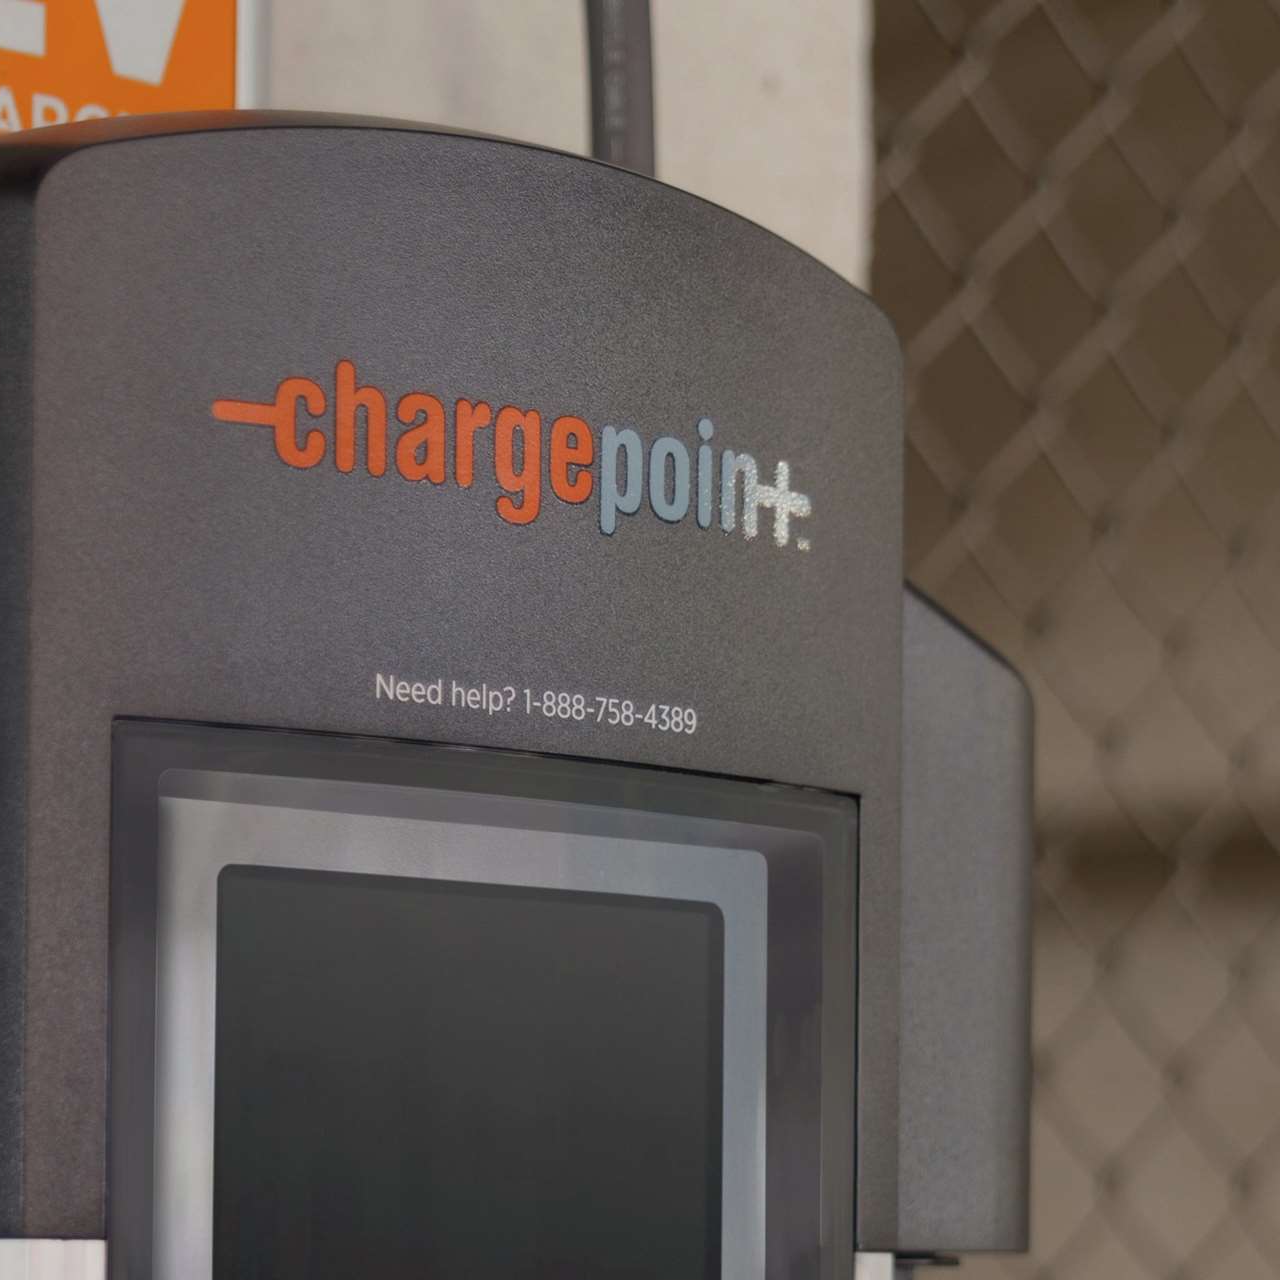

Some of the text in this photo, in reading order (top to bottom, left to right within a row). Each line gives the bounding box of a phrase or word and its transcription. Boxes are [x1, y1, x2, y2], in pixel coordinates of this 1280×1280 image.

[375, 673, 697, 734] Need help? 1-888-758-4389
